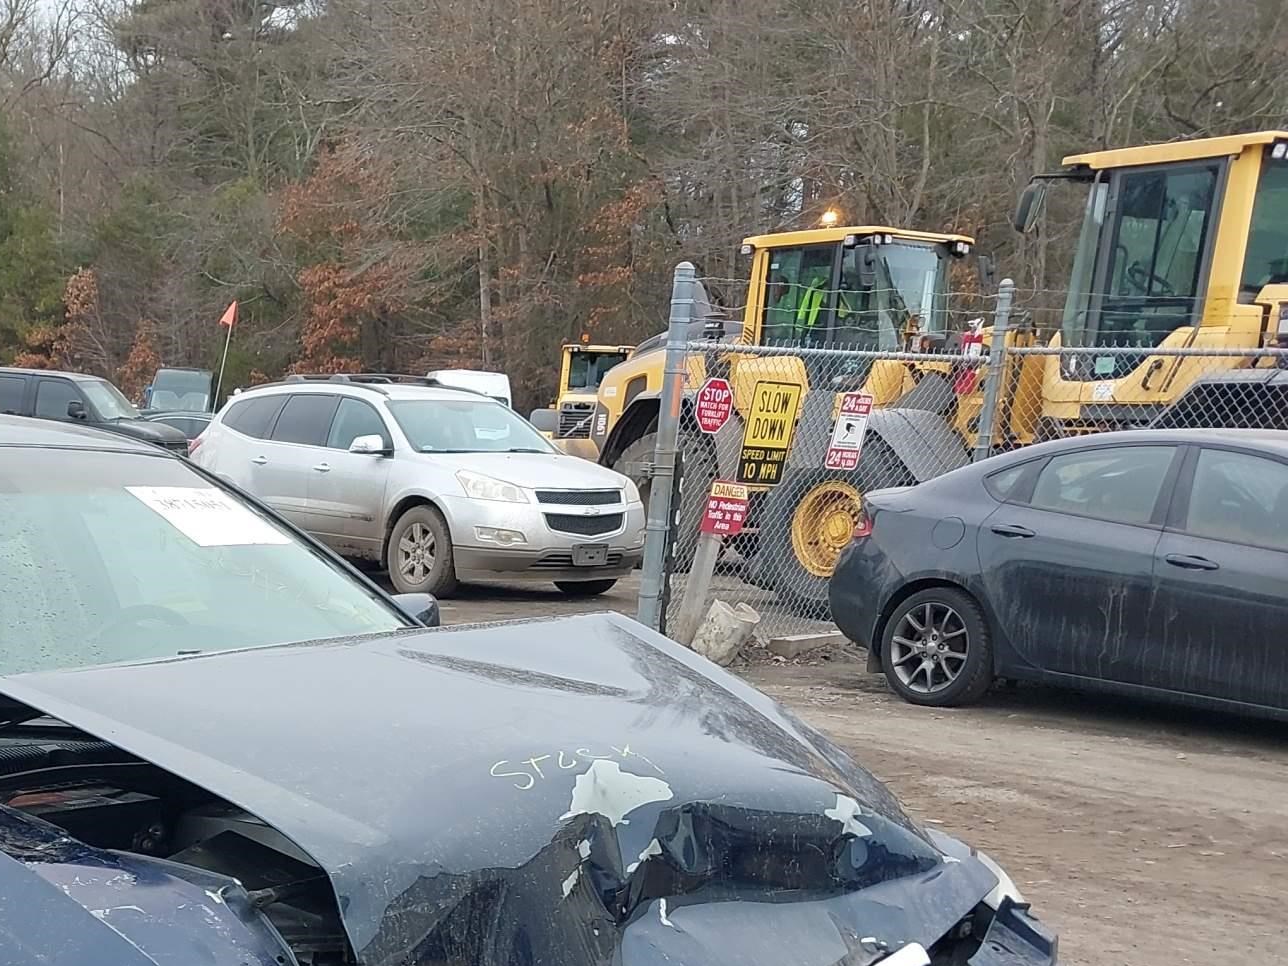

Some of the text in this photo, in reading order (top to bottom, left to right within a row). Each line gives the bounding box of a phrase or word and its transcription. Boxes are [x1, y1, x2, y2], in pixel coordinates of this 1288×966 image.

[704, 387, 729, 402] STOP
[700, 401, 729, 411] WATCH FOR
[759, 390, 792, 414] SLOW
[842, 396, 857, 411] 24
[701, 409, 725, 419] FORKLIFT
[701, 417, 722, 427] TRAFFIC
[752, 417, 787, 440] DOWN
[742, 449, 786, 461] SPEED LIMIT
[828, 450, 842, 465] 24
[743, 462, 778, 480] 10 MPH
[713, 484, 745, 498] DANGER
[708, 500, 746, 511] NO Pedestrian
[707, 510, 743, 522] Traffic in this
[713, 520, 730, 531] Area
